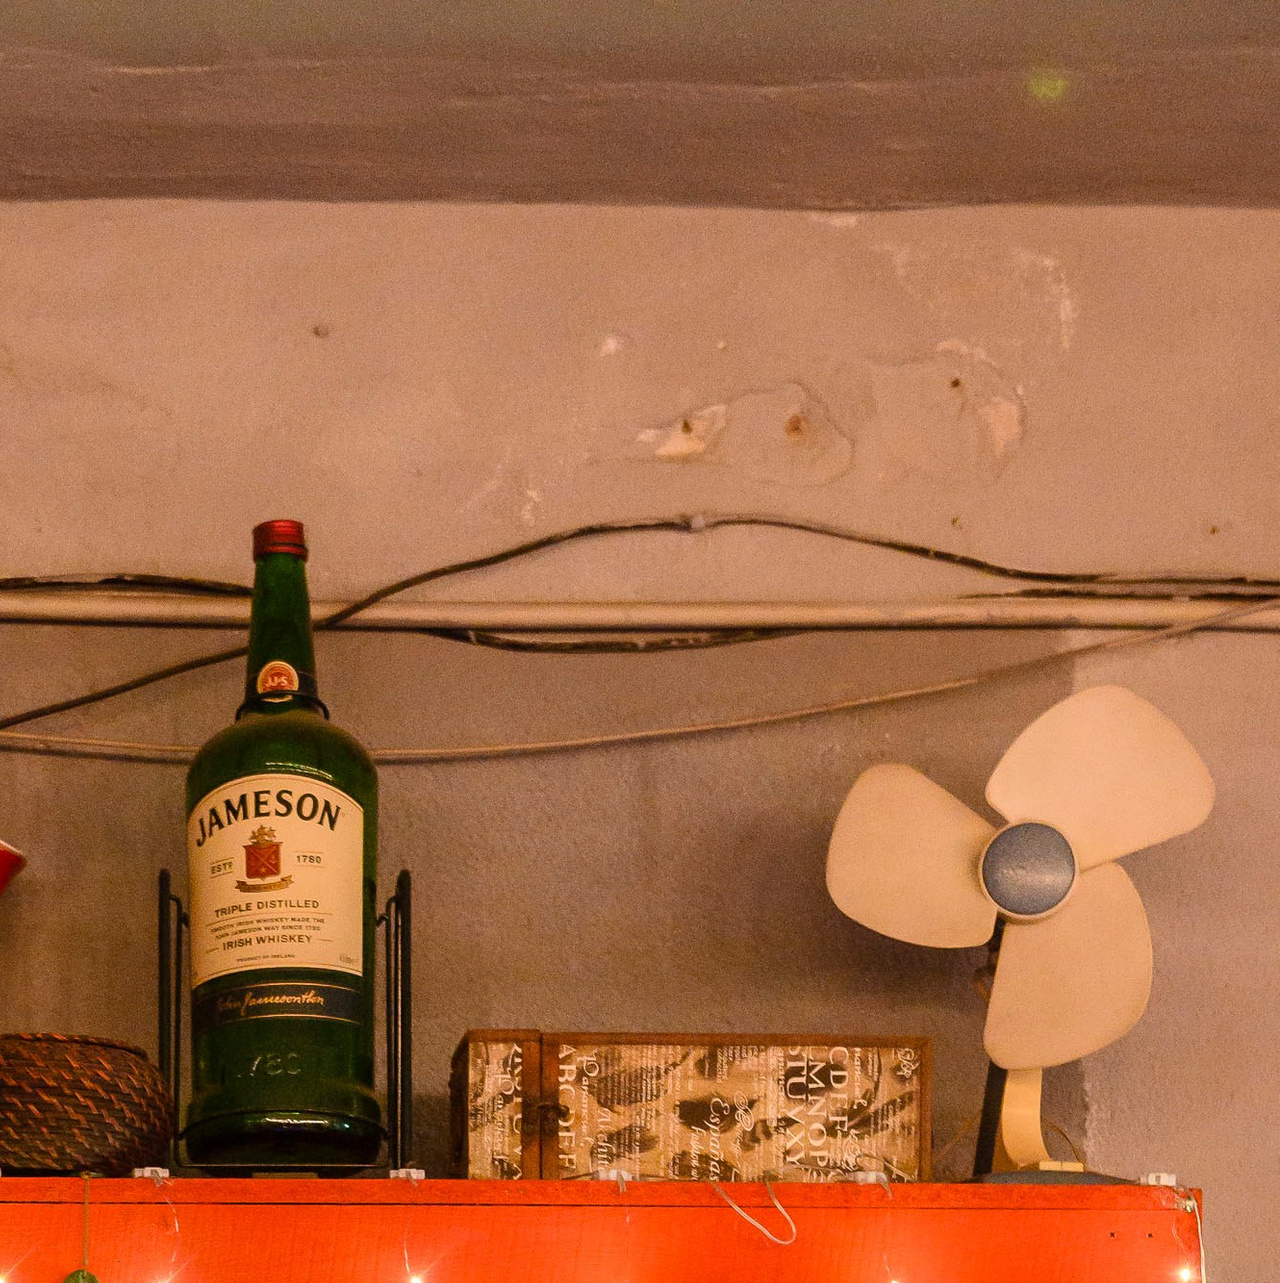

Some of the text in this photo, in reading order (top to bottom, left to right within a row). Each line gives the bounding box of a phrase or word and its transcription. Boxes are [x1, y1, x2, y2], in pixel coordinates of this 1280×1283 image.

[196, 789, 342, 847] JAMESON
[296, 855, 322, 864] 1780
[214, 900, 320, 919] TRIPLE DISTILLED
[236, 920, 254, 928] IRISH
[256, 917, 289, 925] WHISKEY
[231, 927, 263, 937] JAMESON
[222, 934, 313, 951] IRISH WHISKEY
[703, 1098, 730, 1181] Españas
